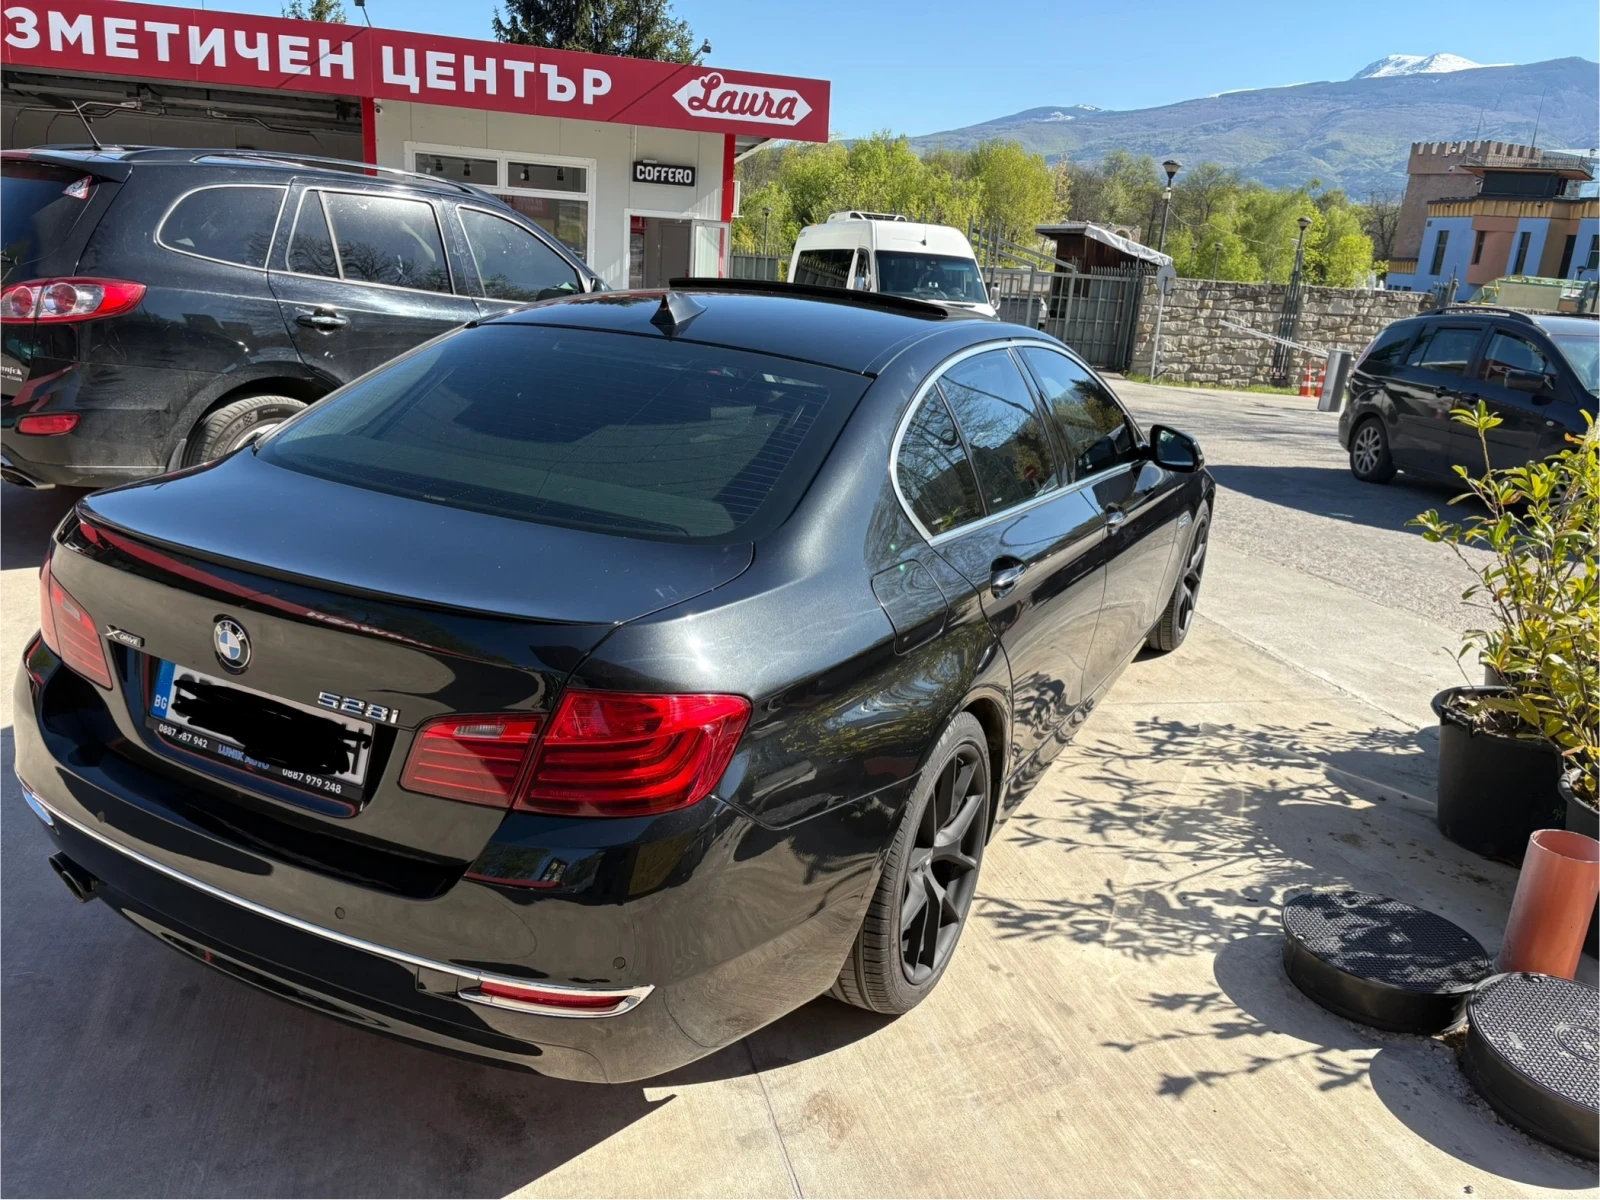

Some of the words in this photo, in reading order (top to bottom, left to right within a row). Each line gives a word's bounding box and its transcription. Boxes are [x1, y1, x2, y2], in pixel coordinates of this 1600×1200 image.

[4, 7, 355, 80] ЗМЕТИЧЕН
[382, 45, 612, 105] ЦЕНТЪР
[688, 74, 798, 120] Laura
[636, 165, 692, 184] COFFERO
[154, 694, 168, 710] BG
[158, 723, 177, 737] 0887
[193, 736, 208, 748] 942
[305, 774, 322, 787] 979
[323, 780, 342, 794] 248
